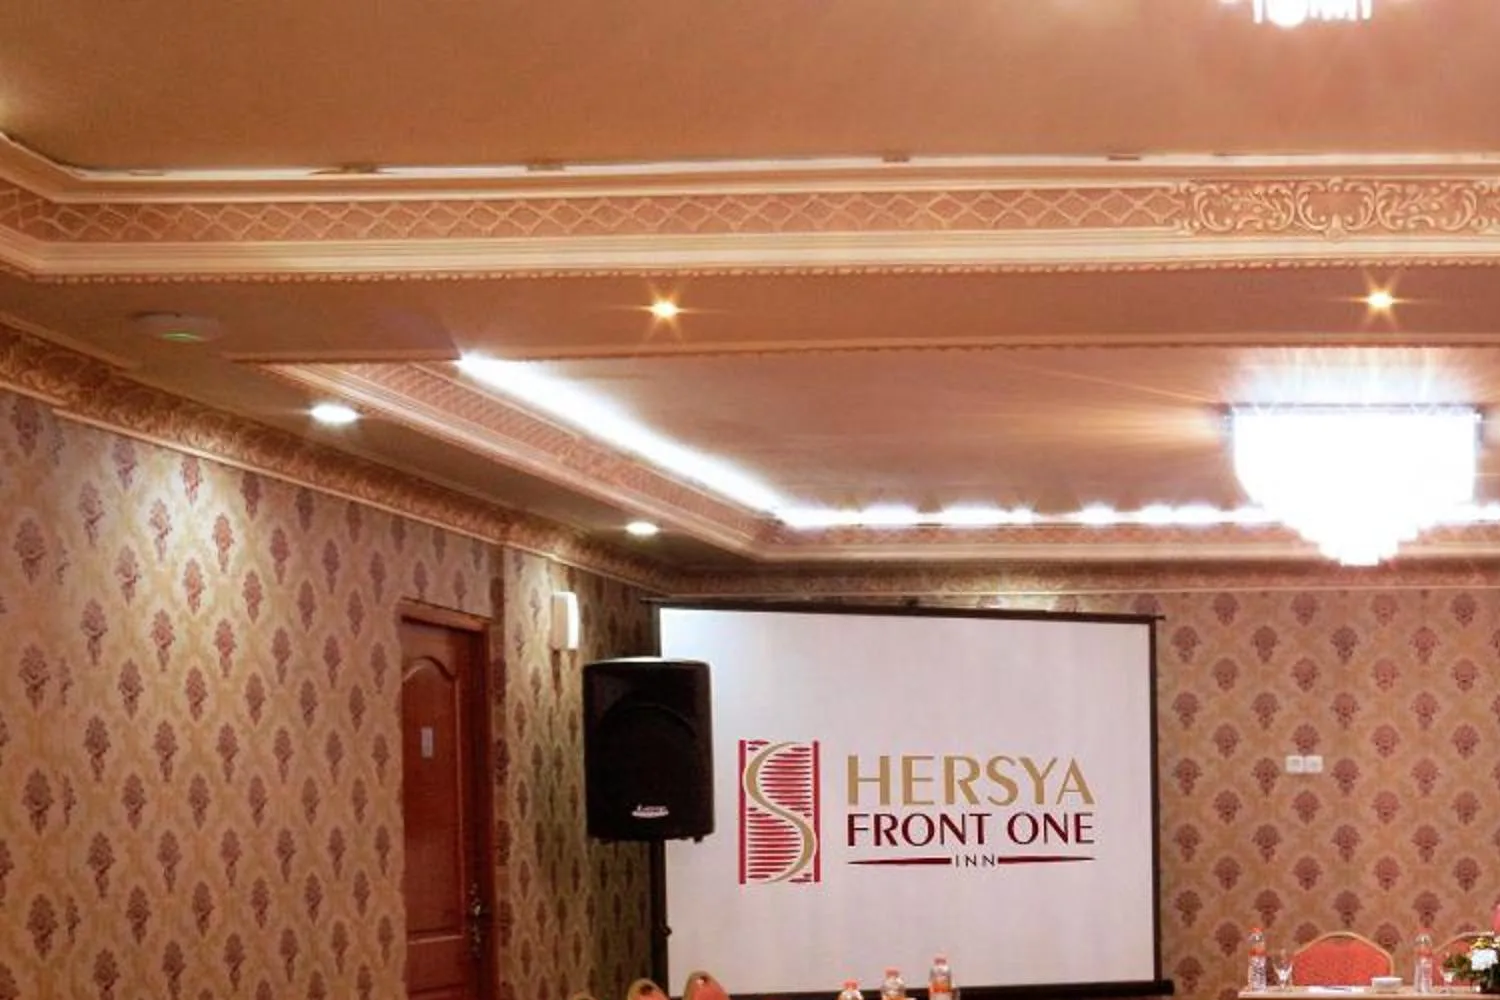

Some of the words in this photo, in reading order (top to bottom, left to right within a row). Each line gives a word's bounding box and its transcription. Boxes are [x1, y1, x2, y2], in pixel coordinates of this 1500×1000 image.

[848, 756, 1095, 805] HERSYA
[847, 813, 992, 846] FRONT
[1007, 812, 1094, 844] ONE
[955, 854, 996, 867] INN
